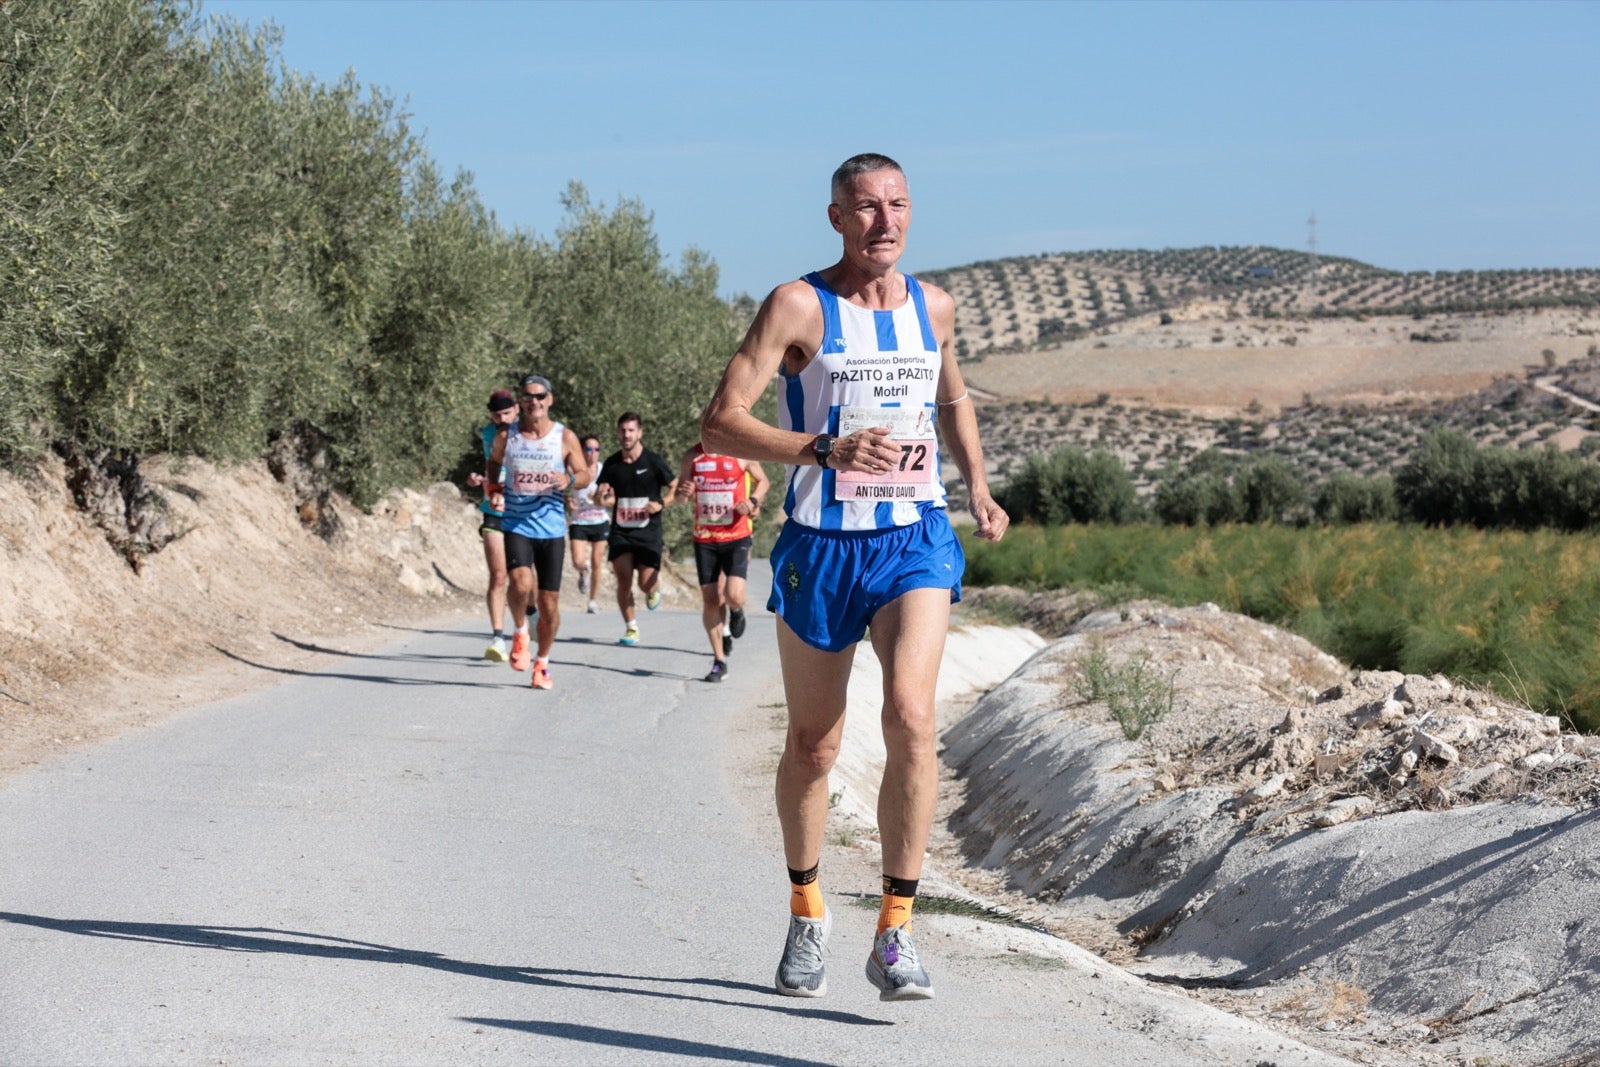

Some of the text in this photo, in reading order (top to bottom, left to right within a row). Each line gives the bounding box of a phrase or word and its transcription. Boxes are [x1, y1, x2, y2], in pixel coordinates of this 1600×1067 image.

[846, 356, 926, 366] Asociación Deportiva
[831, 368, 934, 383] PAZITO a PAZITO
[873, 385, 908, 397] Motril
[898, 444, 927, 472] 72
[518, 473, 549, 484] 2240
[855, 485, 916, 498] ANTONIO DAVID
[702, 504, 730, 515] 2181
